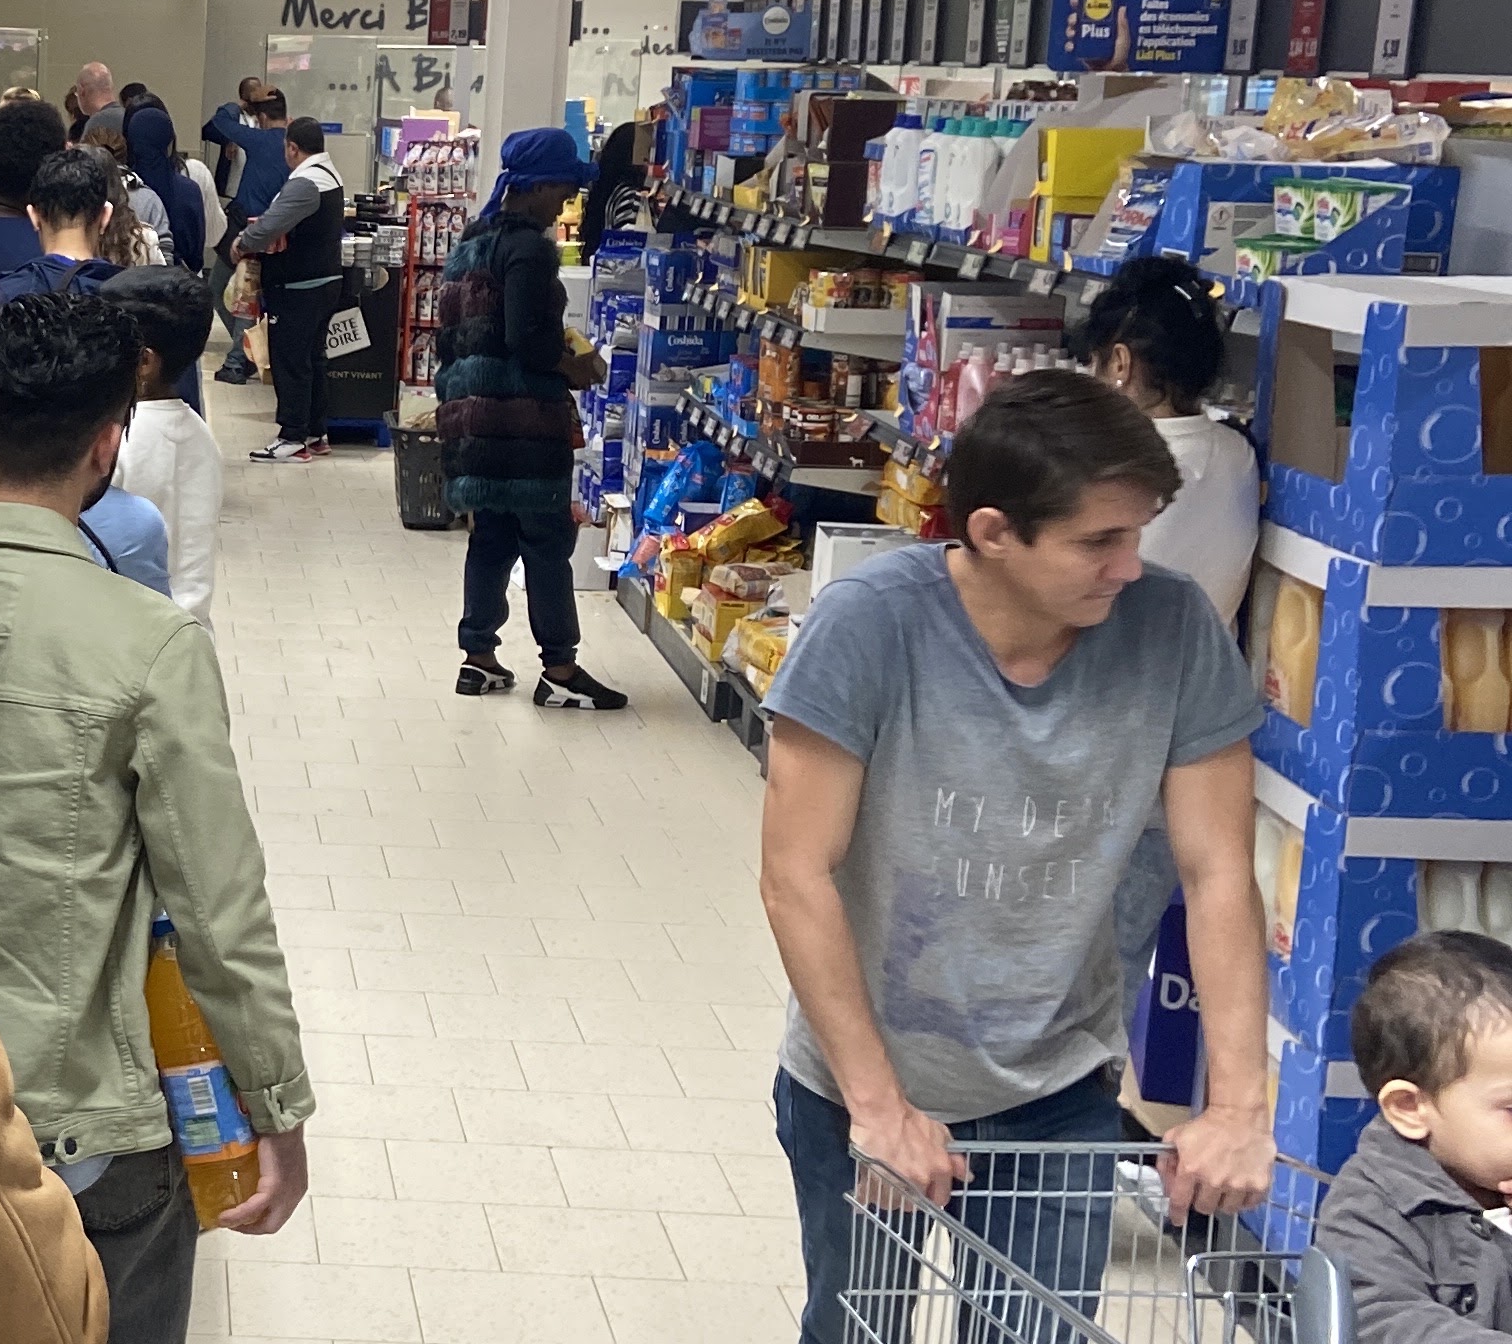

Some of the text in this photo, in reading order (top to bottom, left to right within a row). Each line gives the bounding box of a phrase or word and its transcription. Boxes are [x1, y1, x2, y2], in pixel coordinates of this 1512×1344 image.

[1081, 24, 1111, 39] Plus
[325, 329, 363, 350] OIRE
[934, 787, 986, 833] MY
